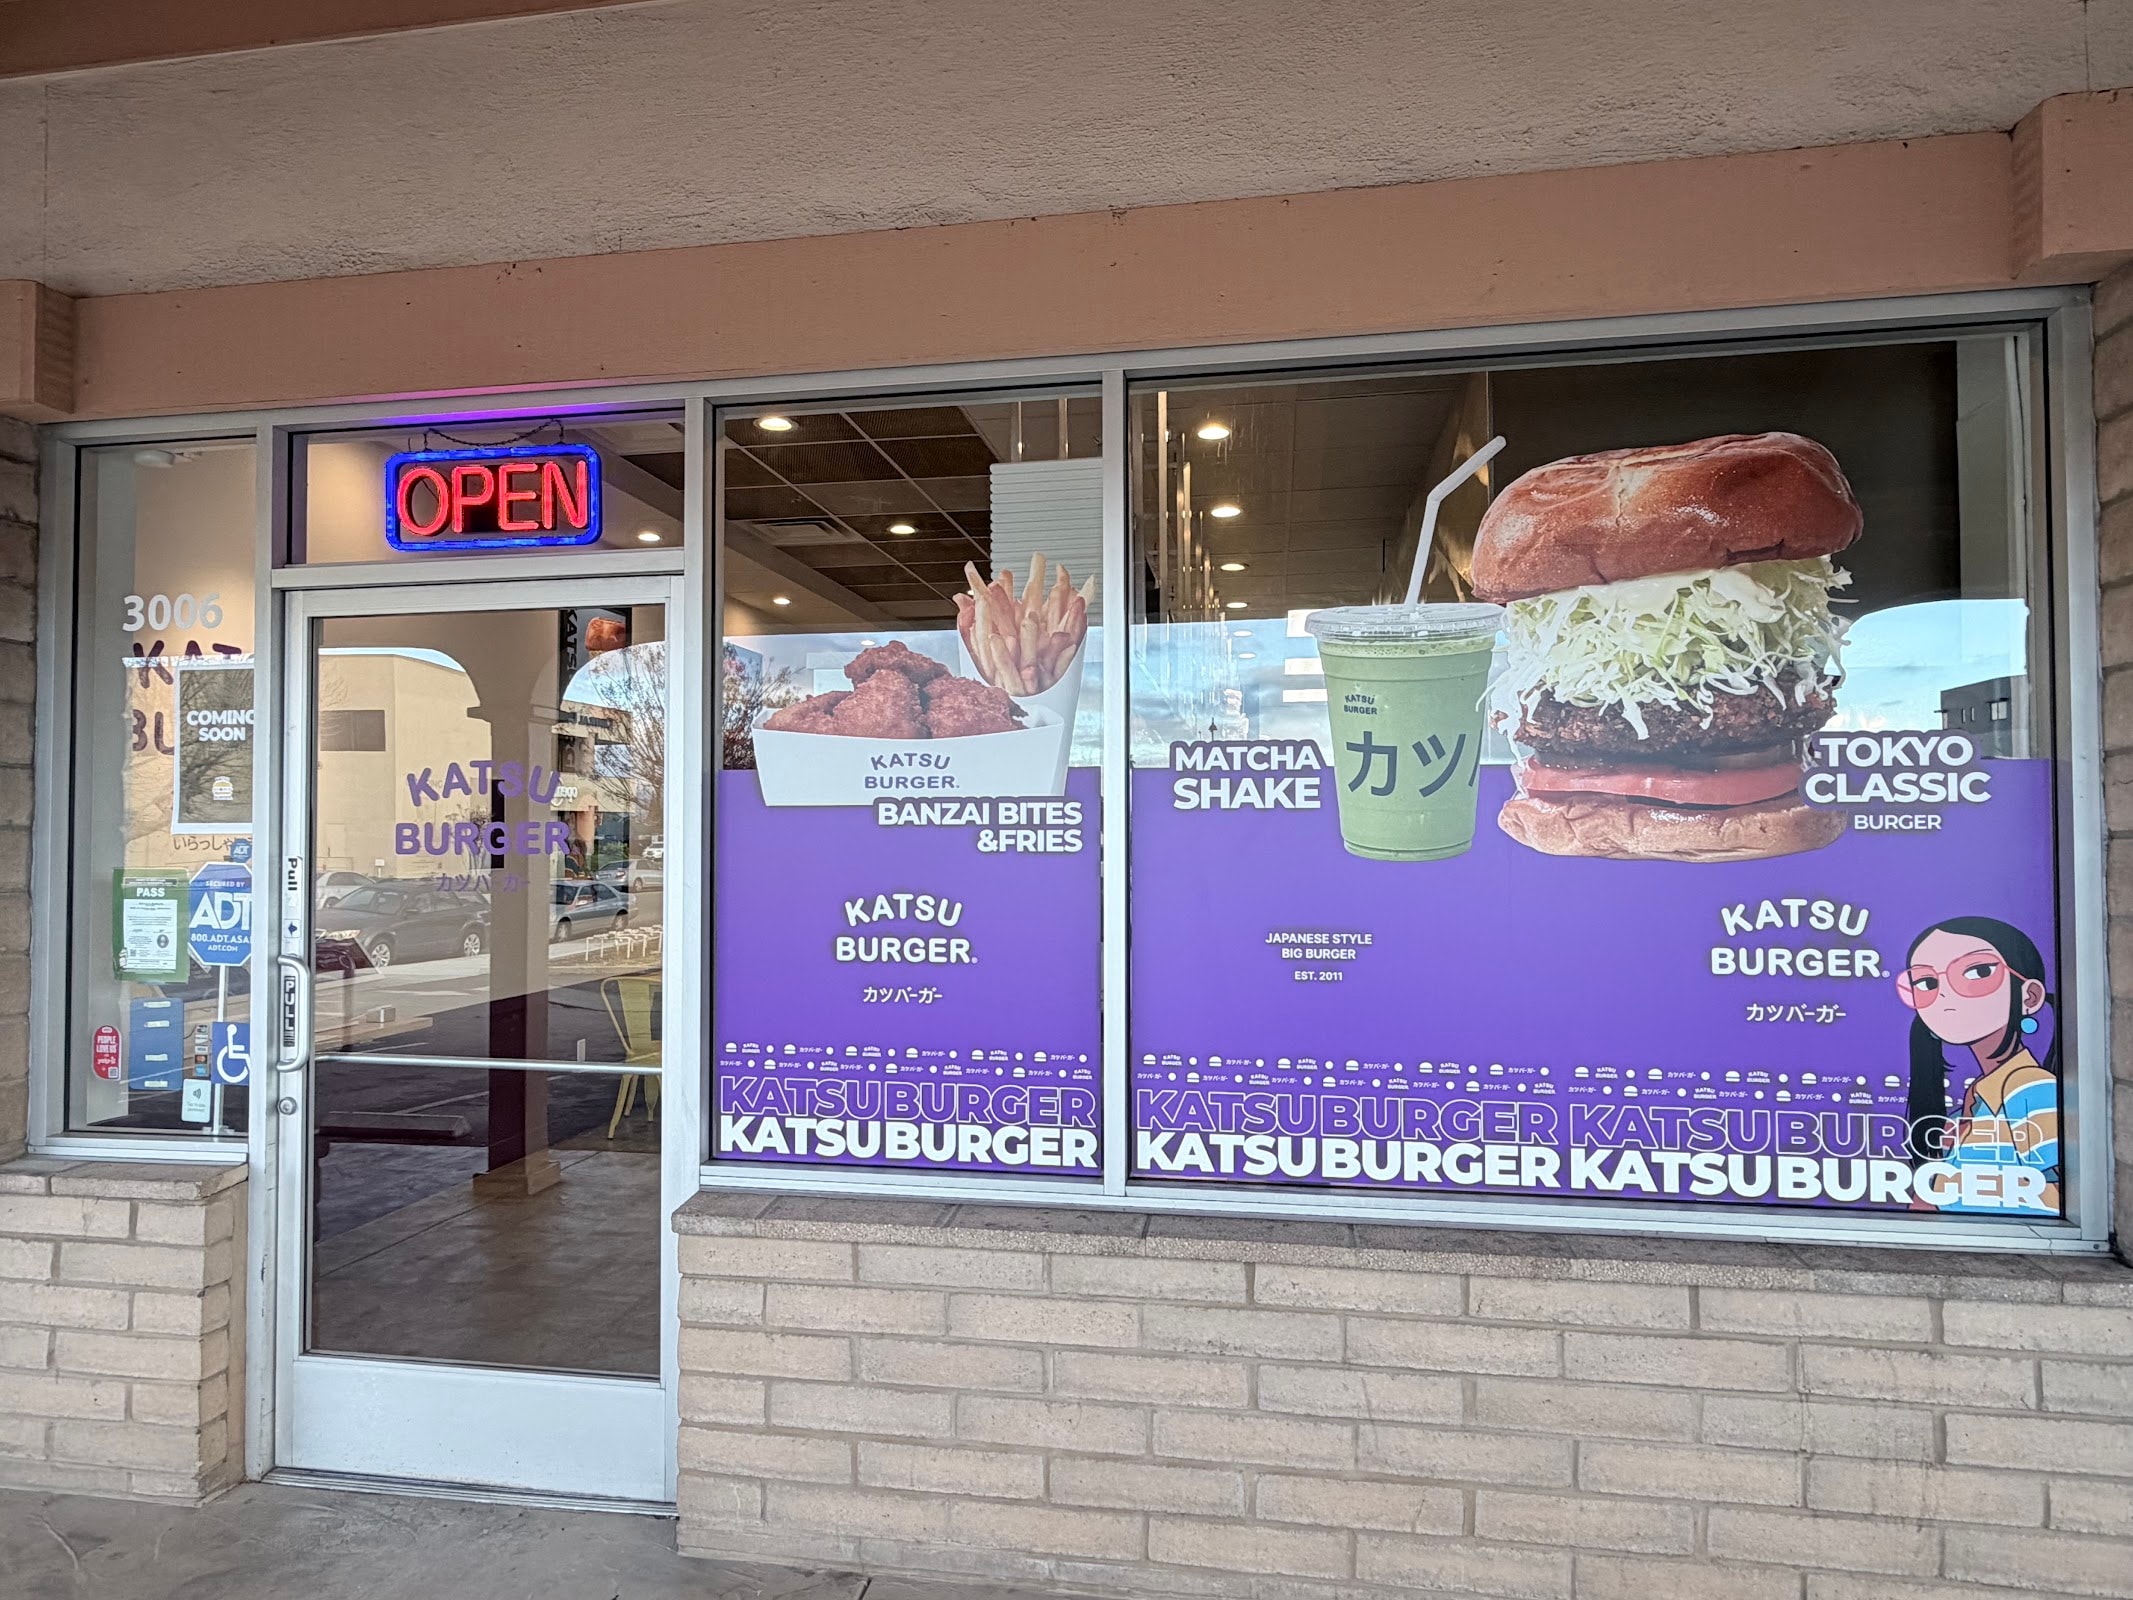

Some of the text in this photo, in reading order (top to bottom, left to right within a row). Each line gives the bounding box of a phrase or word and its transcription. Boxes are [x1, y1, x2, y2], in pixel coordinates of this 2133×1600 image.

[397, 460, 588, 536] OPEN
[122, 594, 223, 632] 3006
[1343, 705, 1378, 715] BURGER
[1345, 694, 1375, 705] KATSU
[199, 727, 246, 742] SOON
[870, 752, 951, 771] KATSU
[1175, 745, 1321, 772] MATCHA
[1819, 735, 1973, 769] TOKYO
[407, 760, 561, 807] KATSU
[1173, 776, 1321, 810] SHAKE
[1805, 771, 1992, 804] CLASSIC
[878, 801, 1083, 826] BANZAI BITES
[1854, 814, 1942, 831] BURGER
[395, 821, 571, 856] BURGER
[977, 829, 1083, 853] &FRIES
[205, 880, 235, 888] SECURED
[288, 858, 298, 891] Pull
[136, 887, 165, 898] PASS
[189, 891, 252, 931] ADT
[844, 893, 962, 927] KATSU
[1721, 898, 1869, 936] KATSU
[191, 933, 251, 944] 800.ADT.ASA
[1265, 932, 1372, 945] JAPANESE STYLE
[1281, 948, 1356, 960] BIG BURGER
[1294, 971, 1343, 981] EST. 2011
[284, 980, 295, 1031] PULL
[863, 986, 943, 1004] カツバーガー
[1746, 1003, 1846, 1024] カツバーガー
